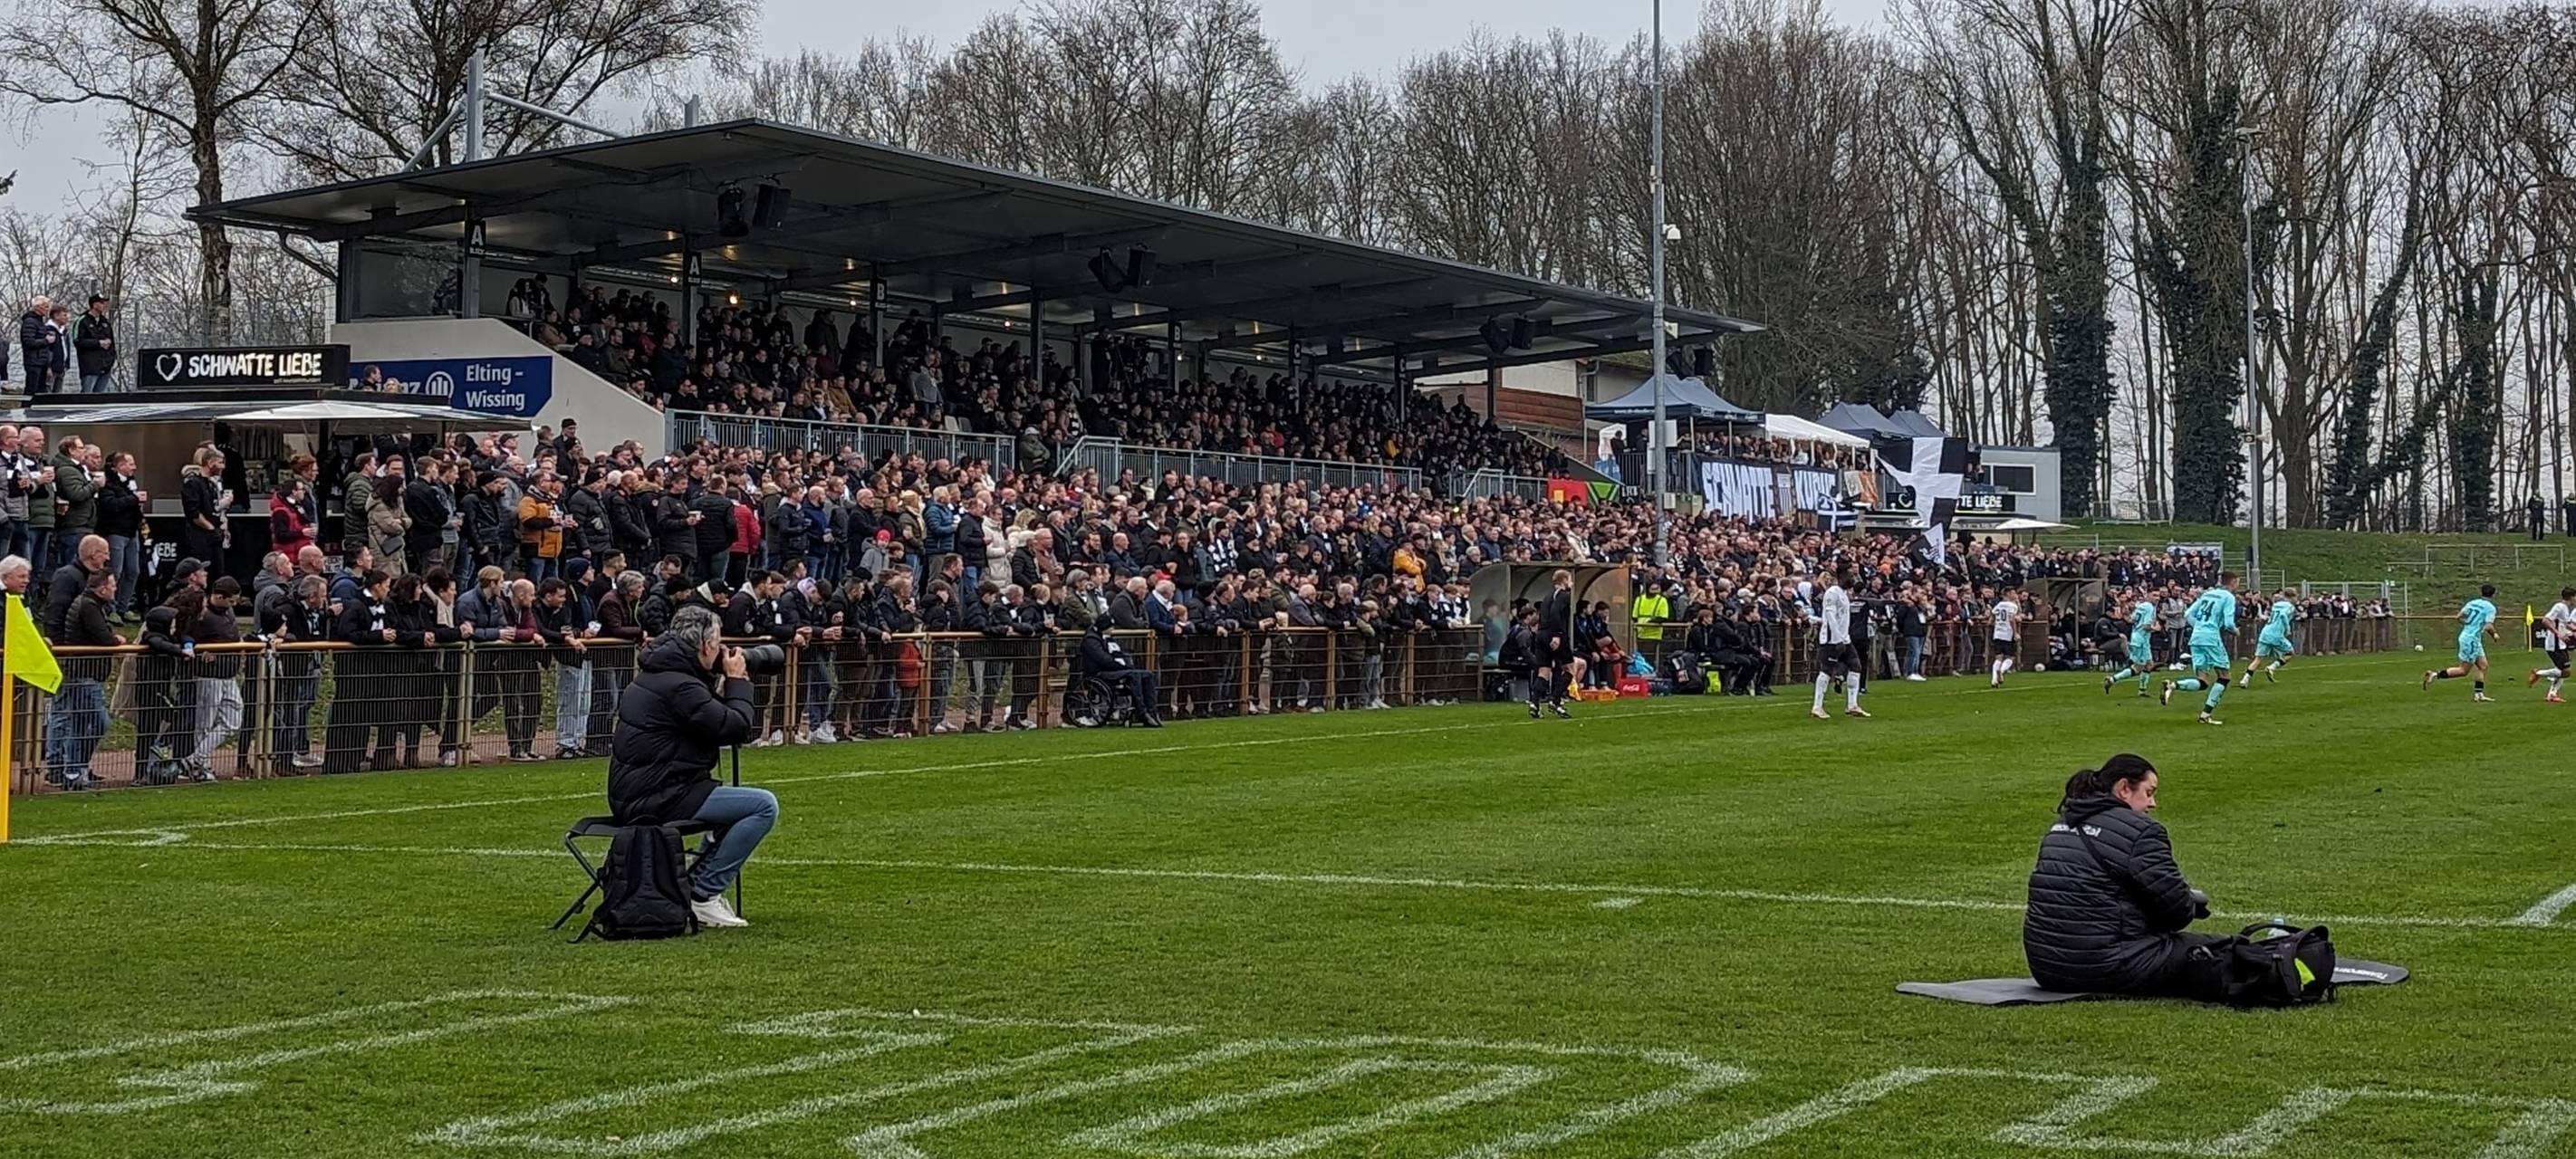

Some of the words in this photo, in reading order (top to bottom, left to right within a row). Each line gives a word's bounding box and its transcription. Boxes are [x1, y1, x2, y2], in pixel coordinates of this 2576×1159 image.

[471, 225, 484, 245] A
[689, 255, 700, 275] A
[876, 283, 885, 300] B
[187, 353, 274, 378] SCHWATTE
[278, 353, 322, 377] LIEBE
[466, 363, 512, 386] Elting
[465, 391, 525, 411] Wissing
[1702, 462, 1777, 525] SCHWATTE
[1975, 494, 2003, 508] LIEBE
